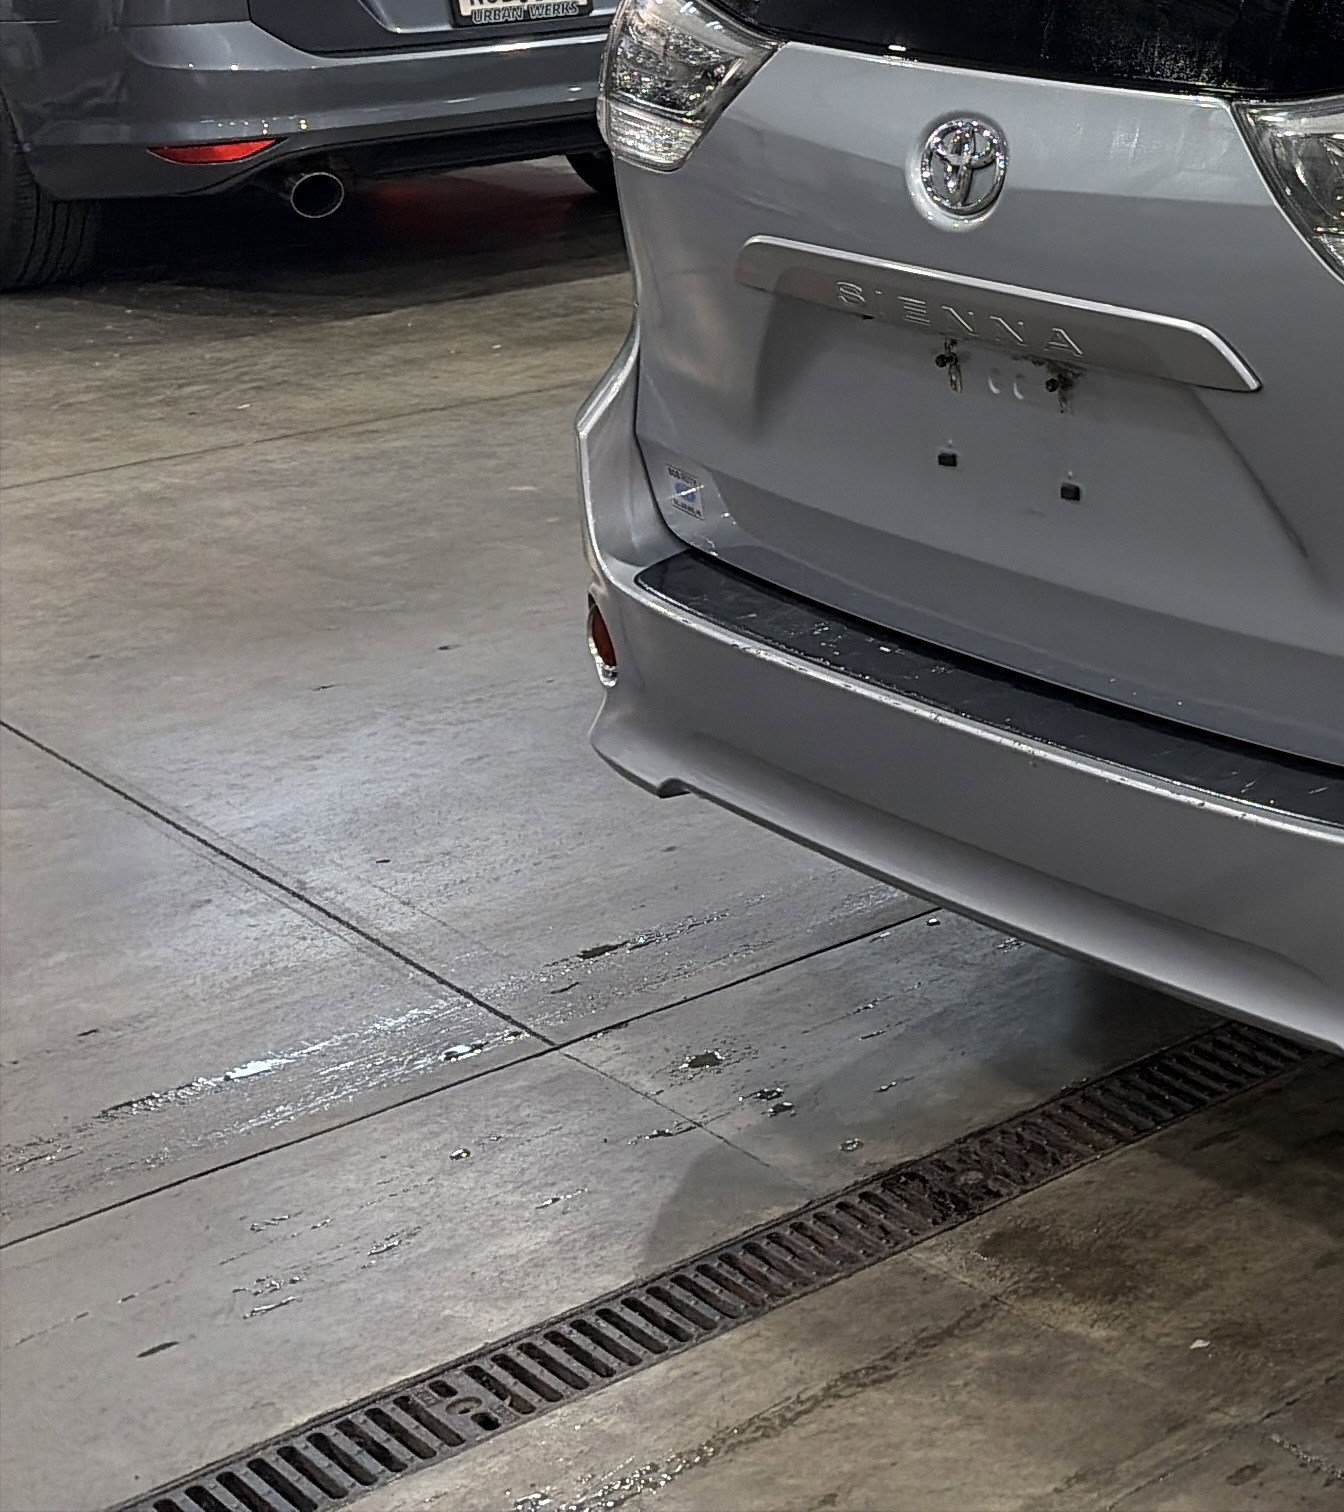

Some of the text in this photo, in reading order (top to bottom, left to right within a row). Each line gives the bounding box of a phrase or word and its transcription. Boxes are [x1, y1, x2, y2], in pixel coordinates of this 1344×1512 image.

[472, 0, 580, 25] URBAN WERKS
[837, 281, 1084, 358] SIENNA
